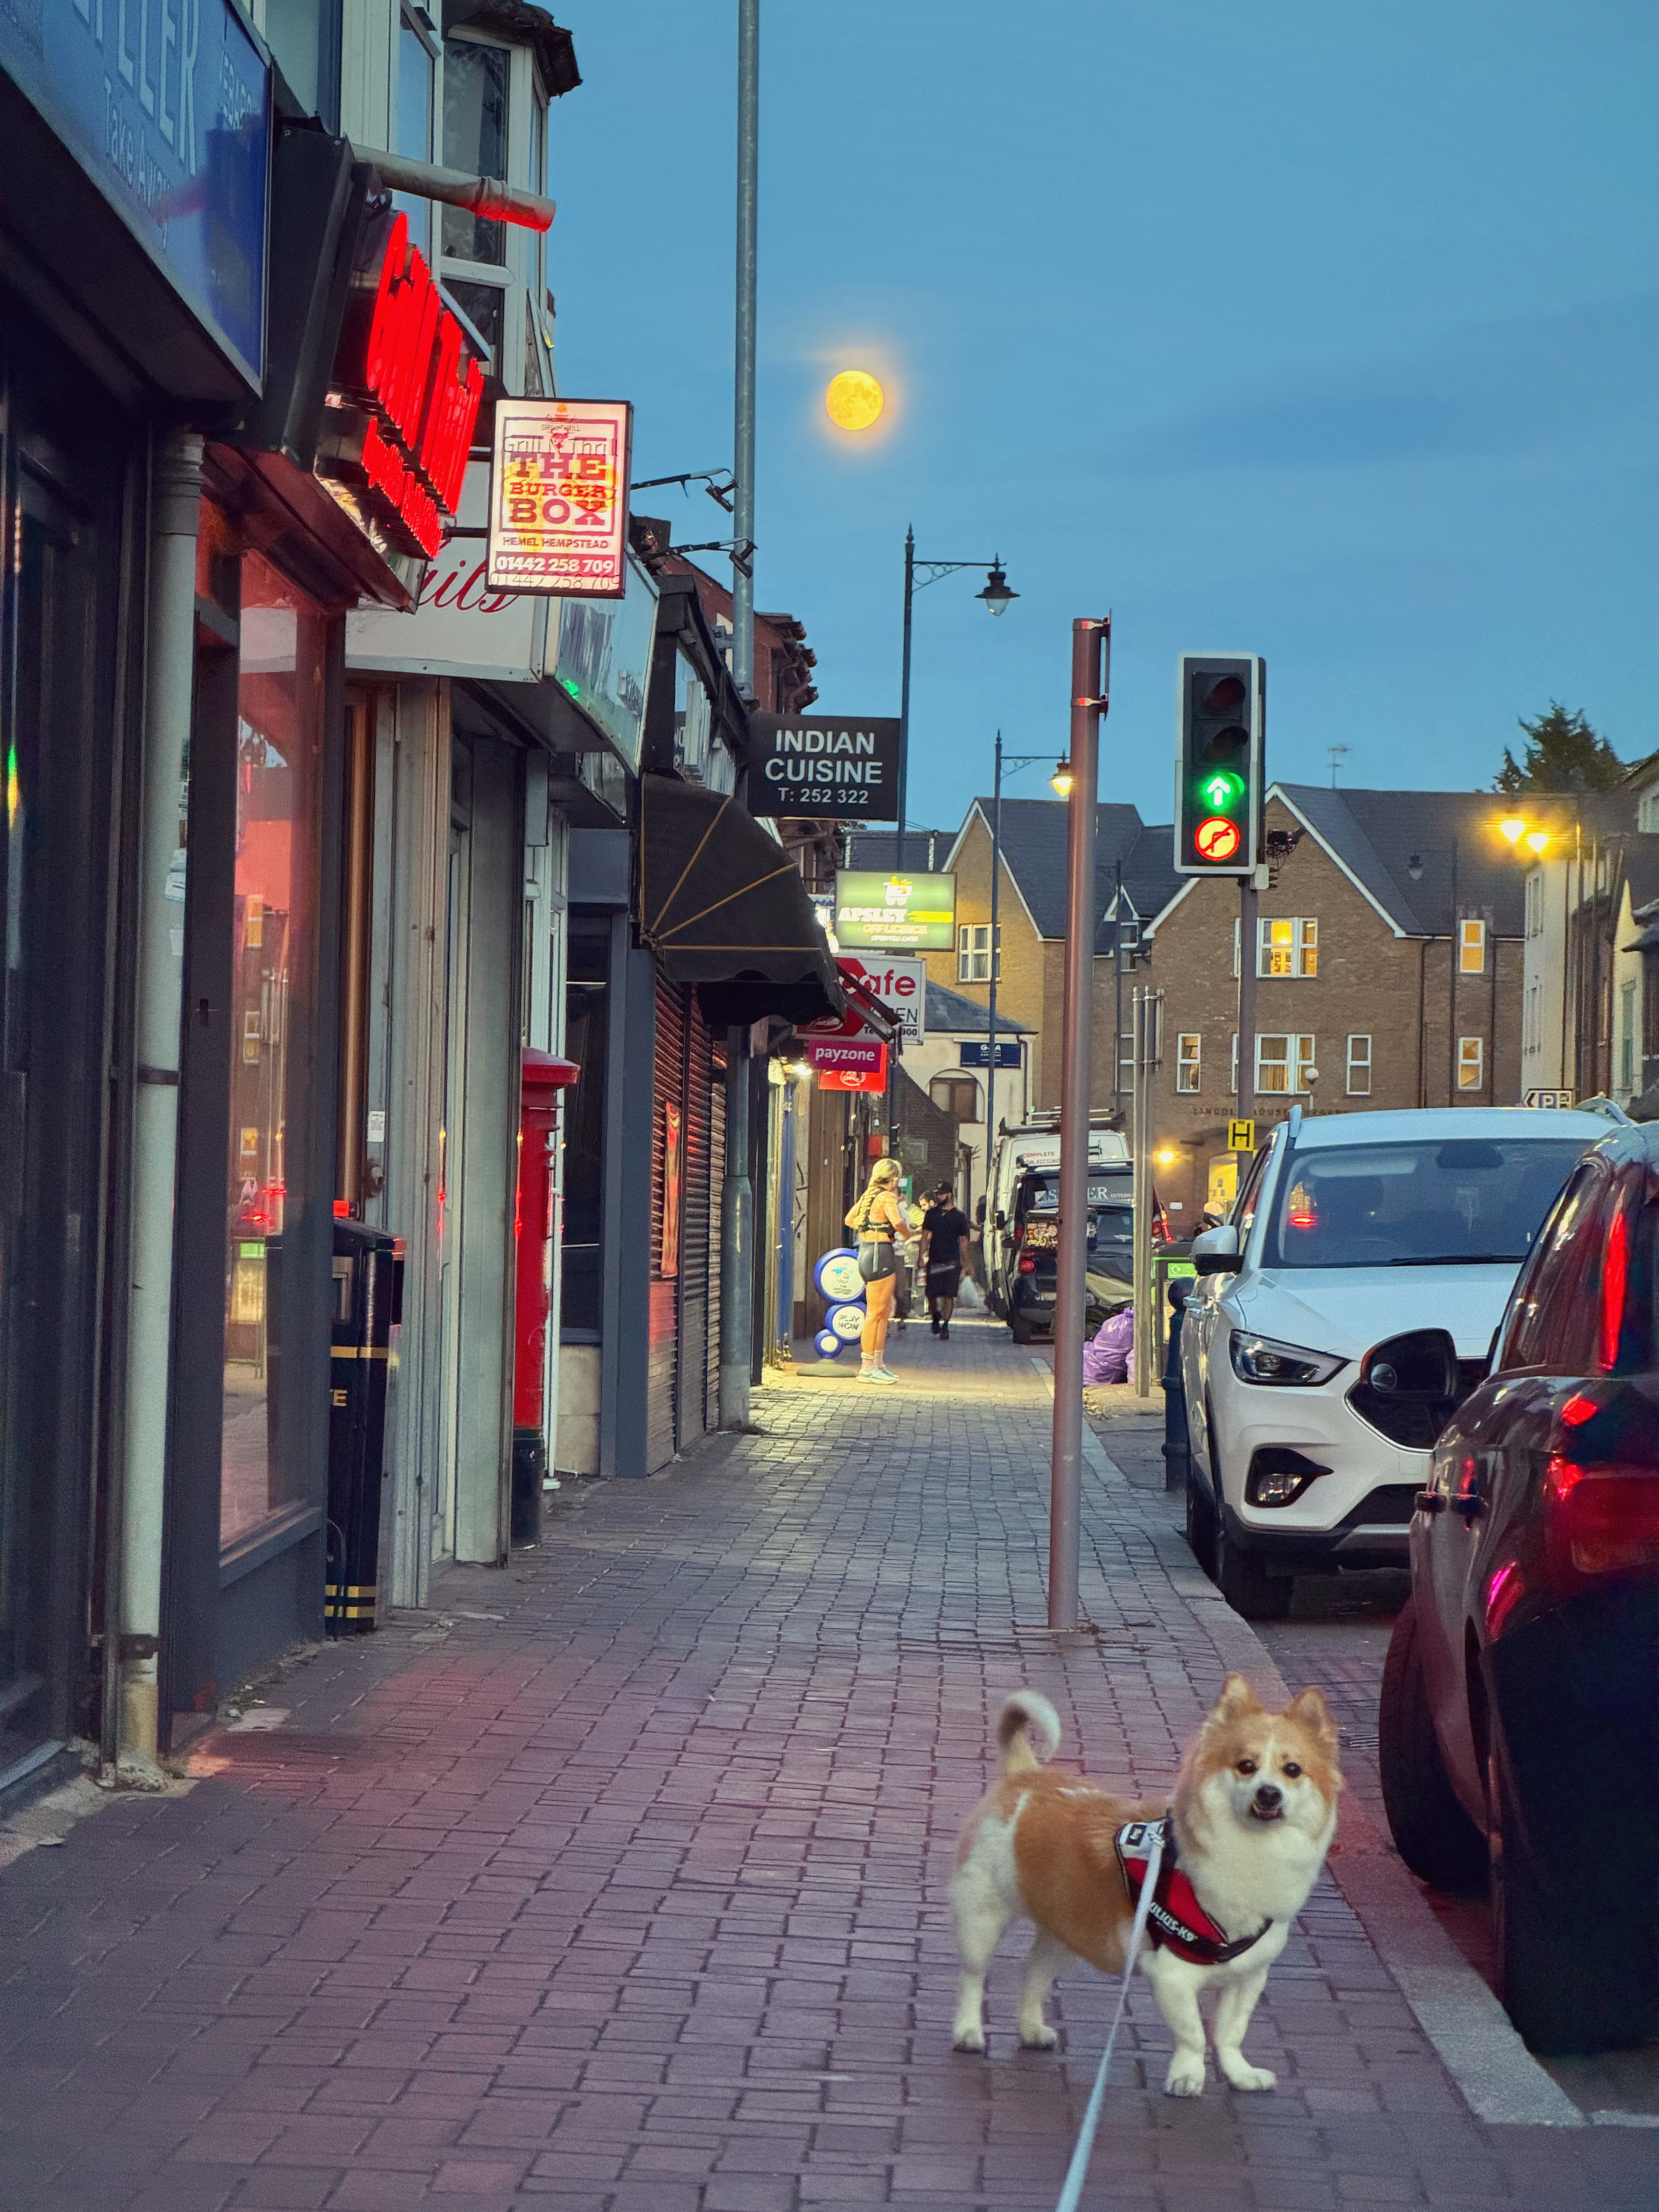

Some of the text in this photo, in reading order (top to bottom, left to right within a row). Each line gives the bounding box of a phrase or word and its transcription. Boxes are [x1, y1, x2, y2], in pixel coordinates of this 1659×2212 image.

[105, 76, 133, 186] Take
[510, 452, 606, 480] THE
[509, 482, 608, 498] BURGER
[508, 498, 605, 526] BOX
[503, 537, 609, 549] HEMEL HEMPSTEAD
[496, 556, 614, 573] 01442 258 709
[776, 730, 874, 754] INDIAN
[765, 758, 883, 784] CUISINE
[778, 787, 869, 804] T: 252 322
[838, 907, 908, 922] APSLEY
[862, 924, 884, 933] OFF
[815, 1048, 875, 1063] payzone
[1542, 1095, 1554, 1108] P
[1191, 1107, 1237, 1116] LINCOL
[1232, 1122, 1250, 1147] H
[838, 1322, 859, 1330] NOW
